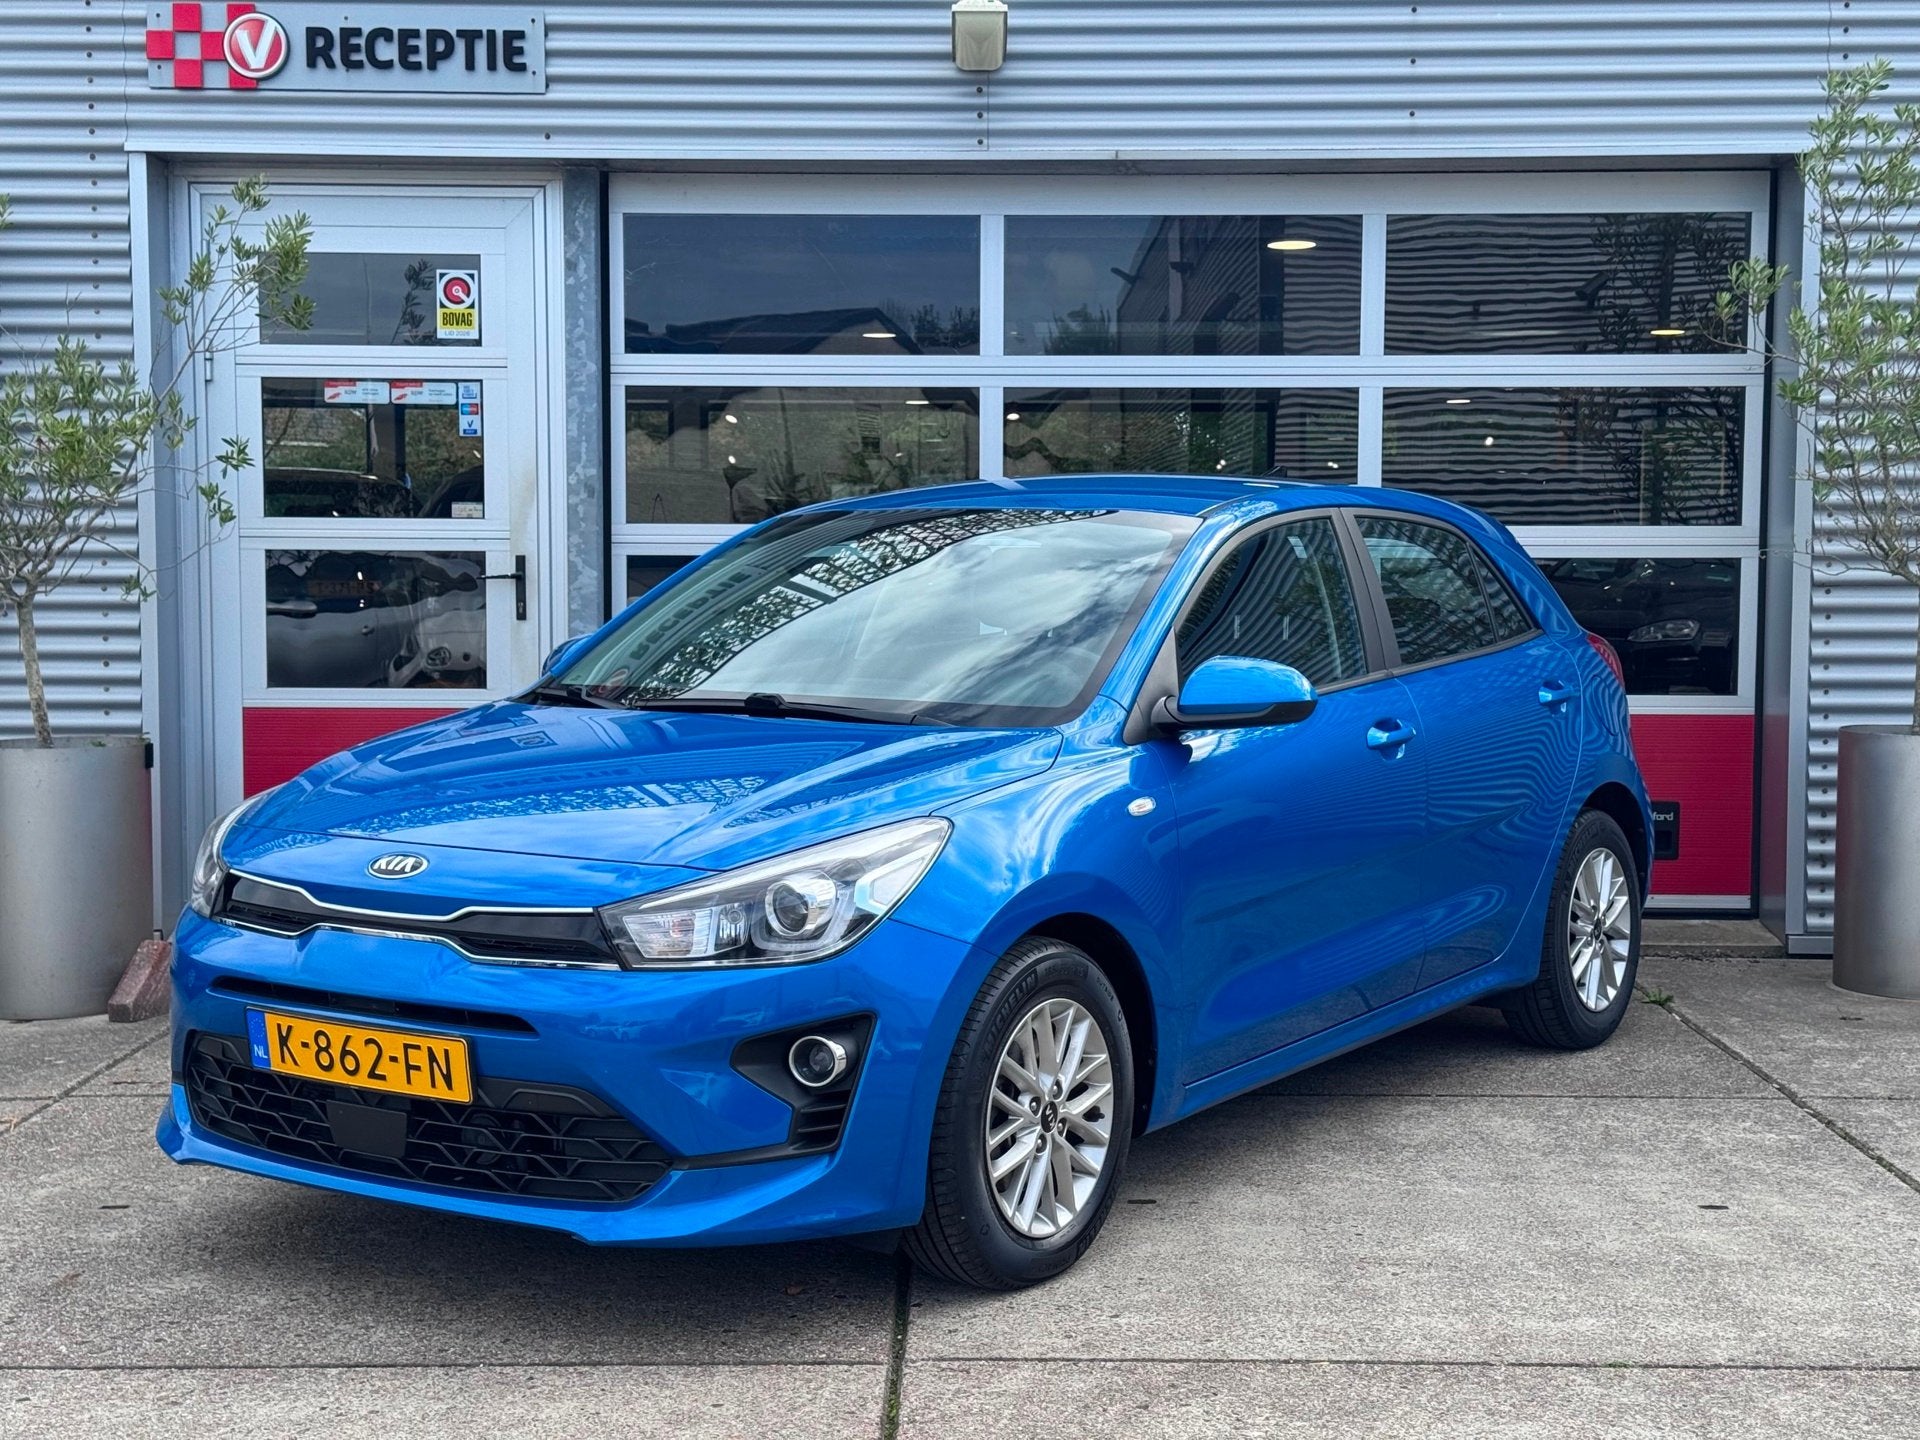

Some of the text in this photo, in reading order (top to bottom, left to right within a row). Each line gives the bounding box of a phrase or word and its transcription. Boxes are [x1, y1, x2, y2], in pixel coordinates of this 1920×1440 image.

[305, 26, 528, 72] RECEPTIE
[442, 311, 473, 327] BOVAG
[373, 855, 416, 873] KIA
[254, 1043, 268, 1059] NL
[276, 1022, 454, 1092] K-862-FN
[1045, 1104, 1056, 1129] KIA
